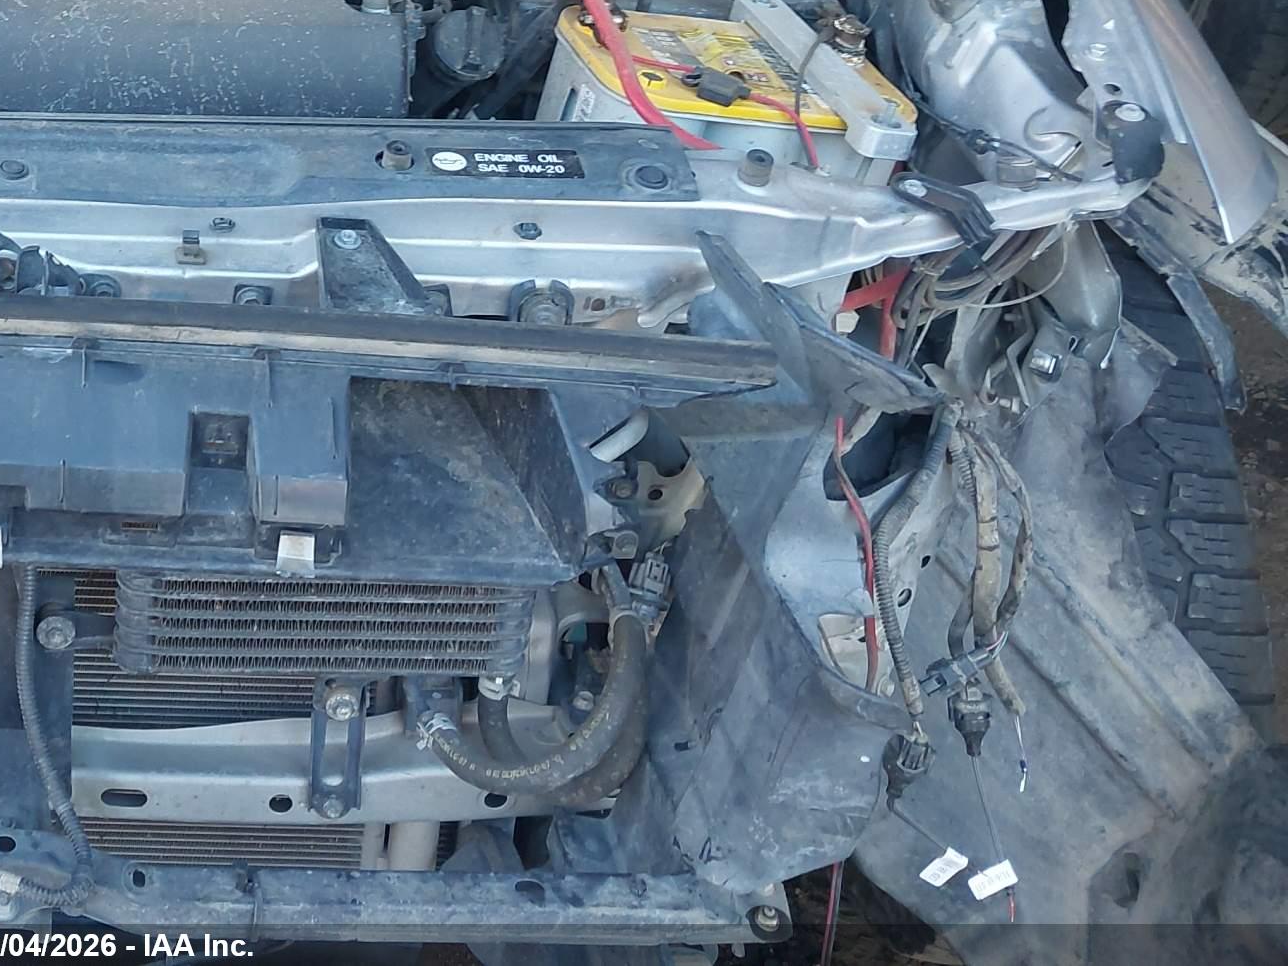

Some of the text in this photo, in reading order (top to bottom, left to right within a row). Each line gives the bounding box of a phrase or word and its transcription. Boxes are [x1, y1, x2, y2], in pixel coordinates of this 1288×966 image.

[474, 153, 564, 163] ENGINE OIL
[477, 163, 566, 174] SAE 0W-20
